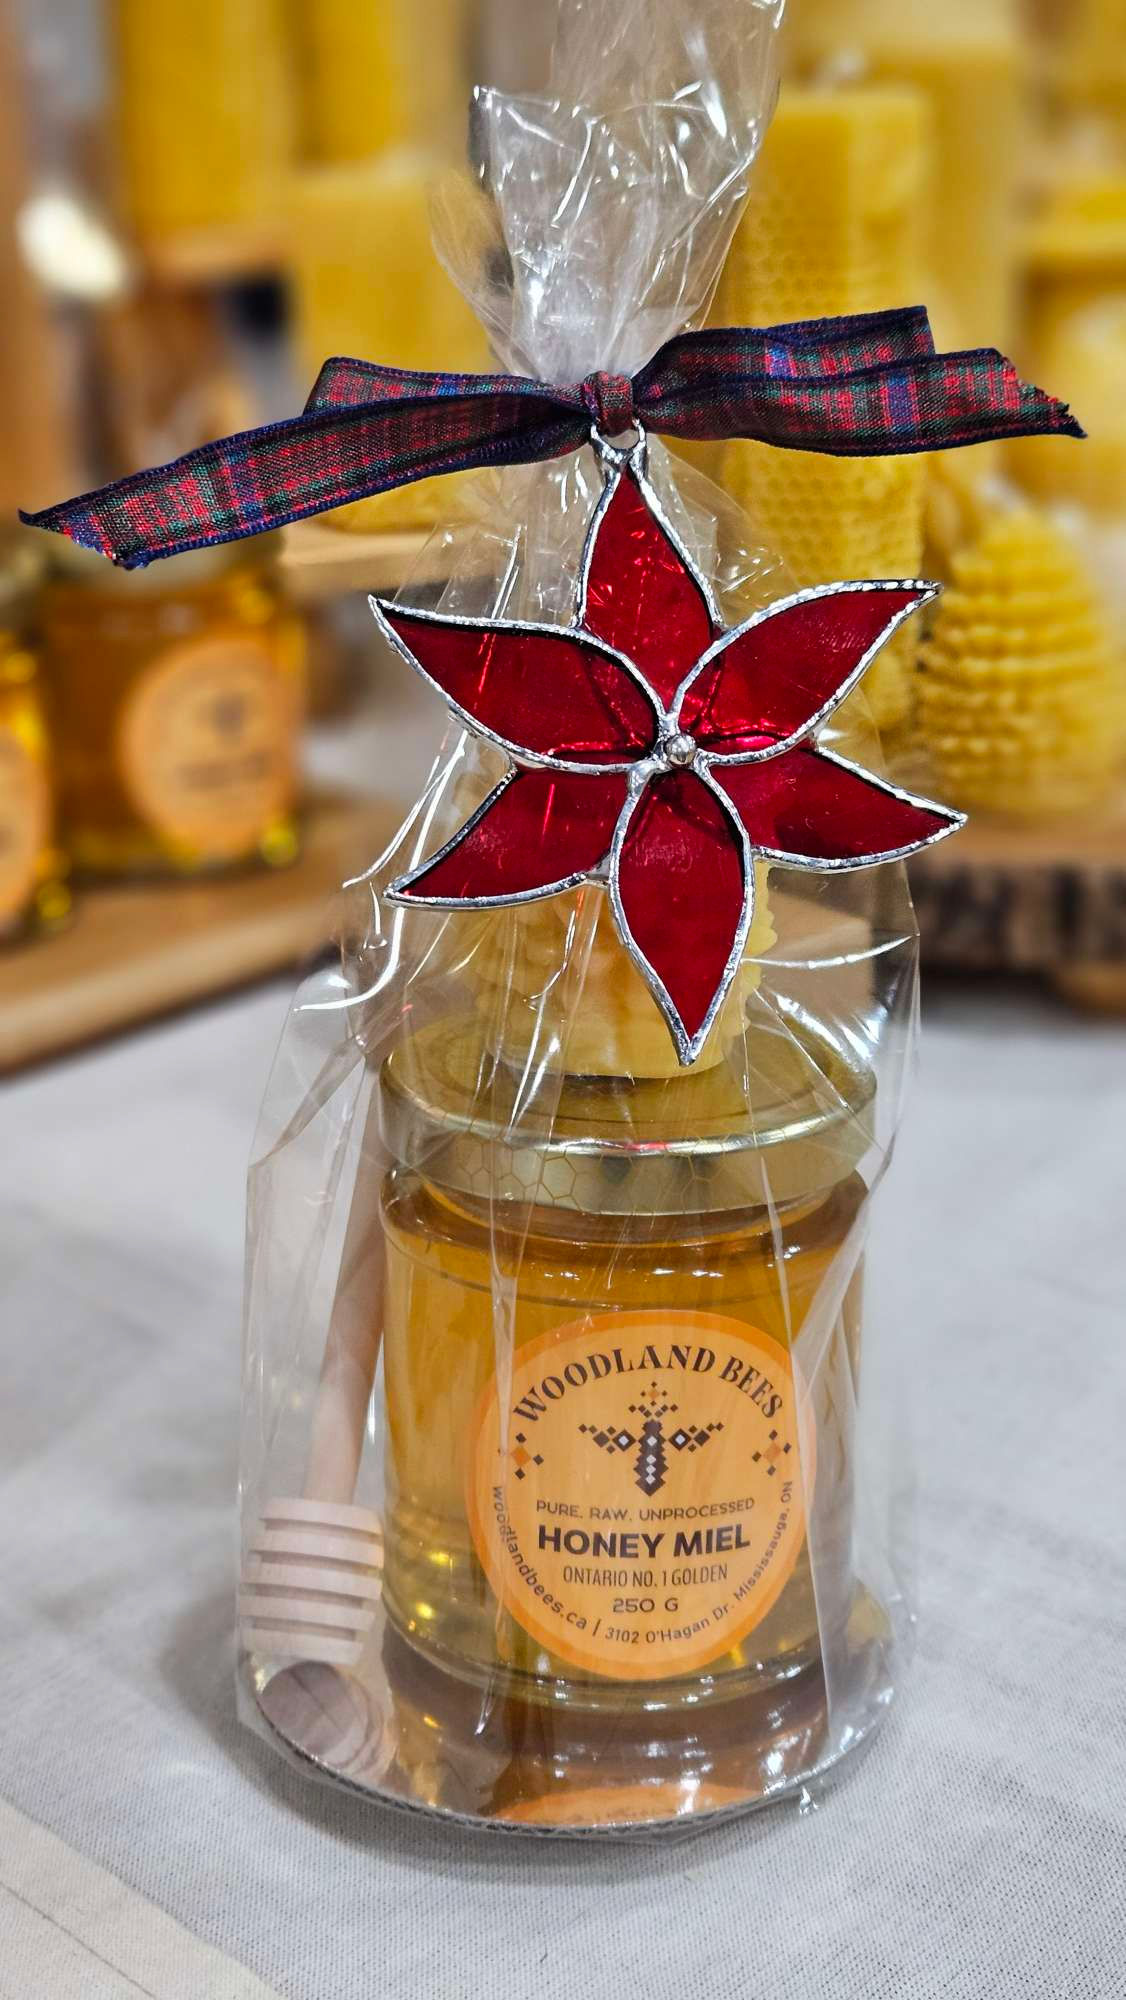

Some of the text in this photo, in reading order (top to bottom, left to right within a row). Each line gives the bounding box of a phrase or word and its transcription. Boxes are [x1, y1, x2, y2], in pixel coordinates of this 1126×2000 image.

[513, 1344, 783, 1422] WOODLAND BEES
[639, 1497, 755, 1521] UNPROCESSED
[538, 1523, 751, 1558] HONEY MIEL
[493, 1486, 587, 1630] woodlandbees.ca
[605, 1627, 640, 1644] 3102
[646, 1618, 711, 1643] O'Hagan
[712, 1603, 735, 1622] Dr.
[780, 1480, 793, 1503] ON
[563, 1563, 728, 1588] ONTARIO NO. 1 GOLDEN
[612, 1597, 679, 1613] 250 G
